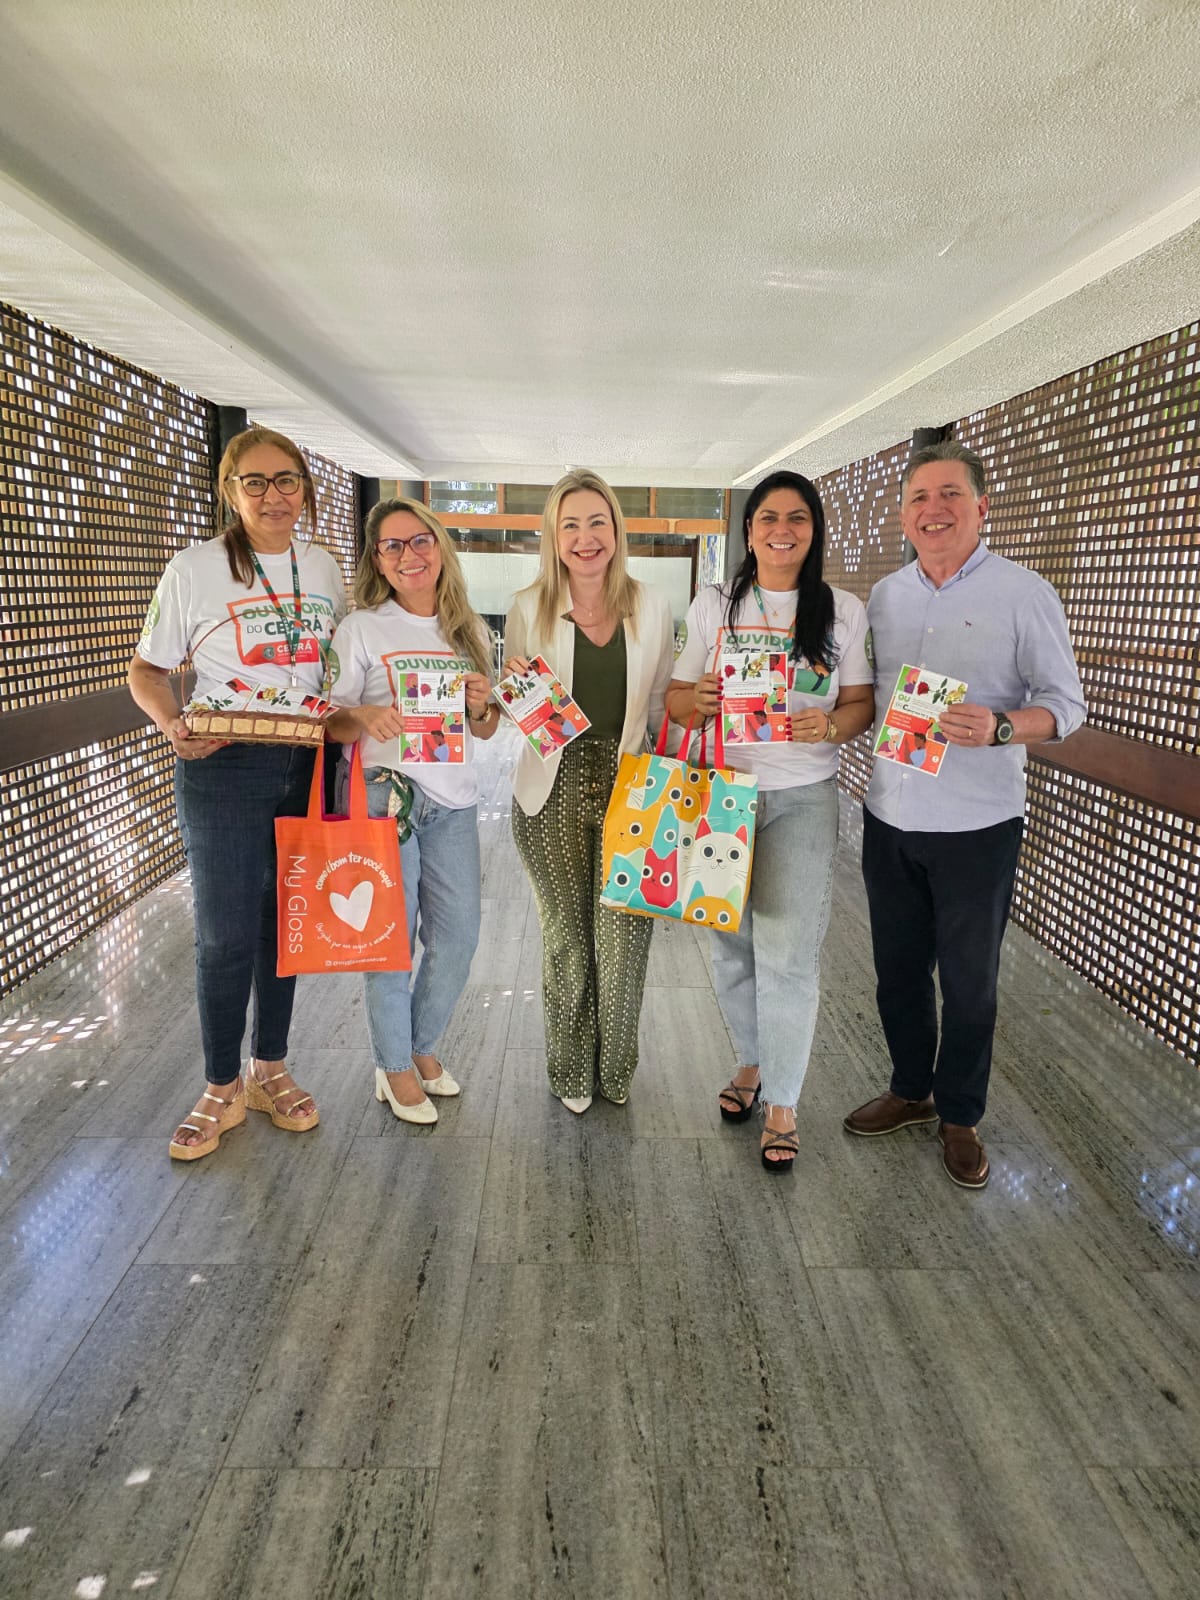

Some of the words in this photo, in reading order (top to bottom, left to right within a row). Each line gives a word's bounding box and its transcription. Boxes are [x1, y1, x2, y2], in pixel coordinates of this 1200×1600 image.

[246, 624, 262, 634] DO
[284, 855, 307, 887] My
[329, 857, 347, 870] bom
[348, 851, 362, 864] ter
[363, 856, 383, 873] você
[379, 869, 397, 889] aqui
[287, 895, 308, 954] Gloss
